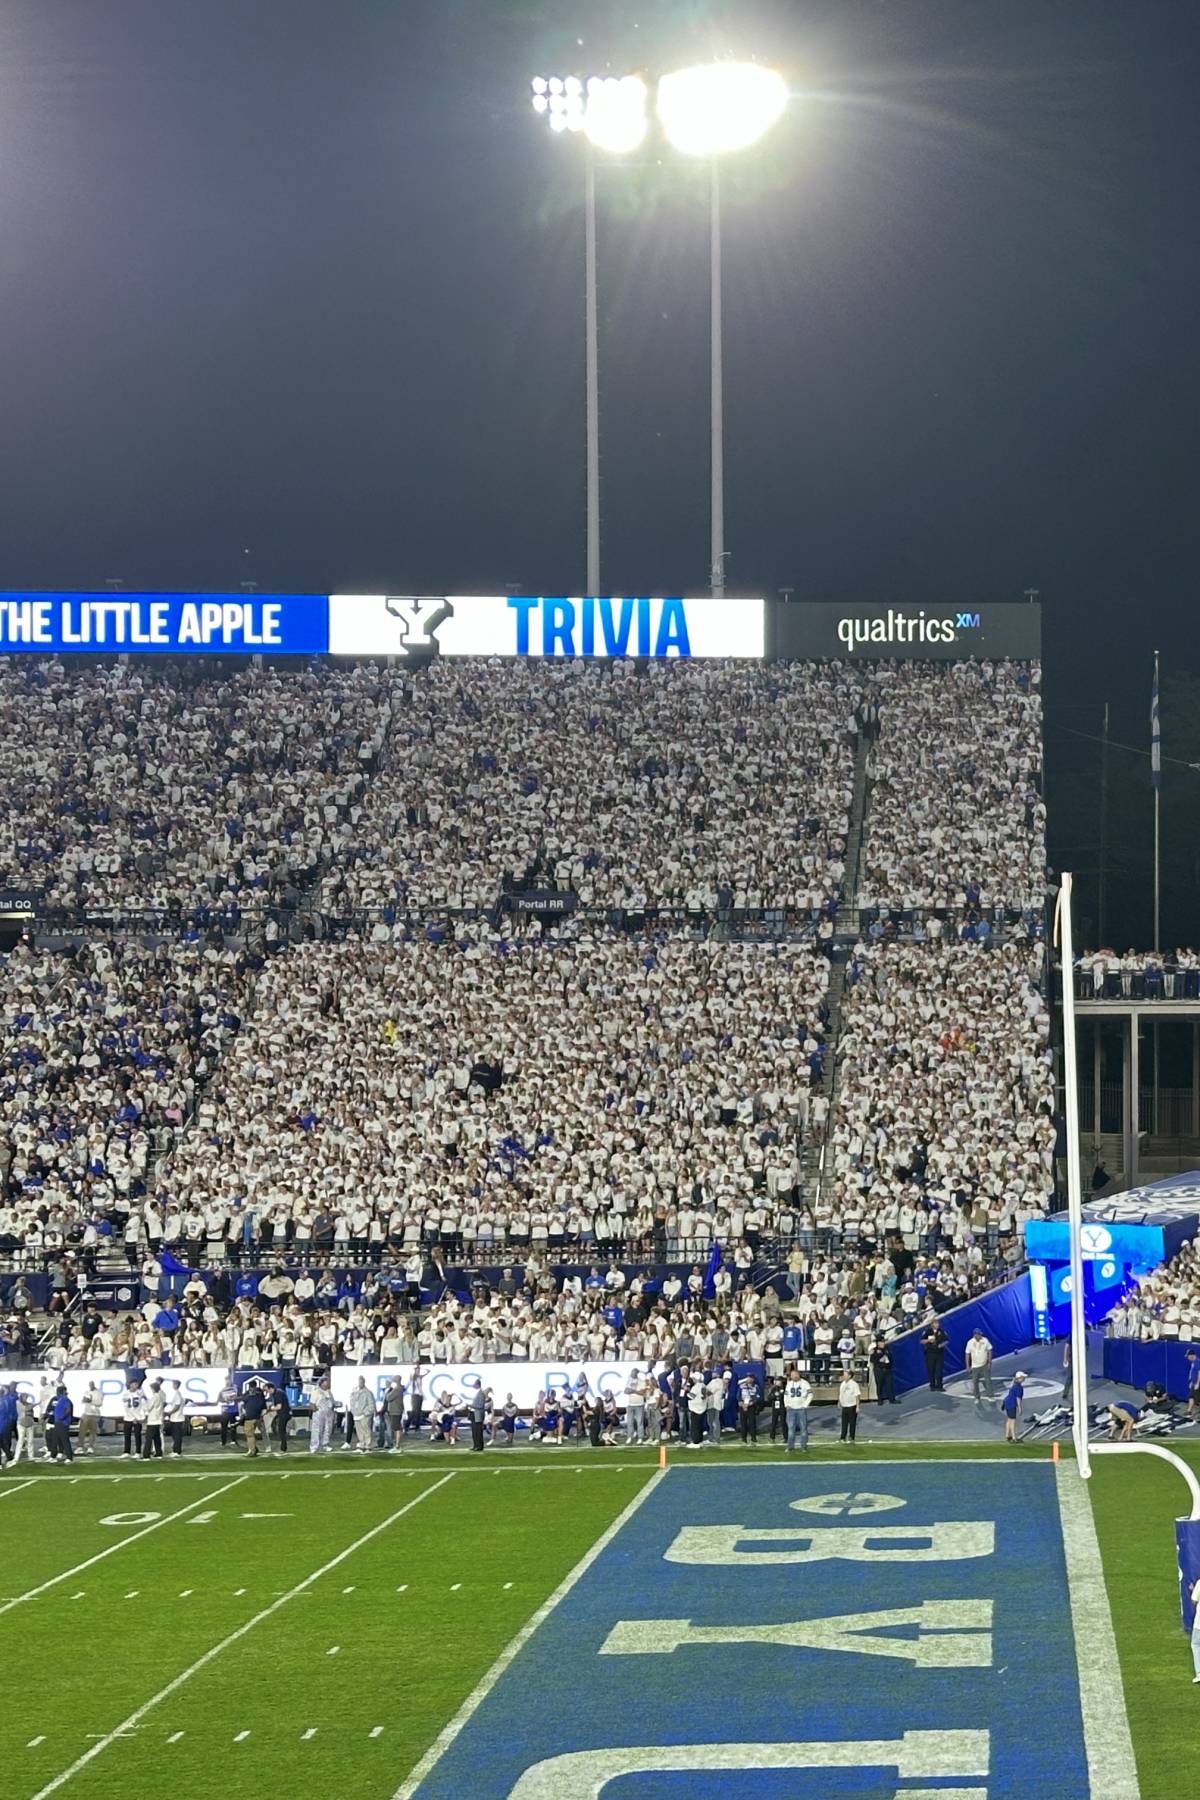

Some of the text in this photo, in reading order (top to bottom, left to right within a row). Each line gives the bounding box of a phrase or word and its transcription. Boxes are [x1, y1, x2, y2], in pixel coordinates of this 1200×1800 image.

[61, 602, 169, 643] LITTLE
[178, 603, 281, 644] APPLE
[507, 597, 691, 657] TRIVIA
[837, 609, 955, 651] qualtrics
[518, 900, 546, 908] Portal
